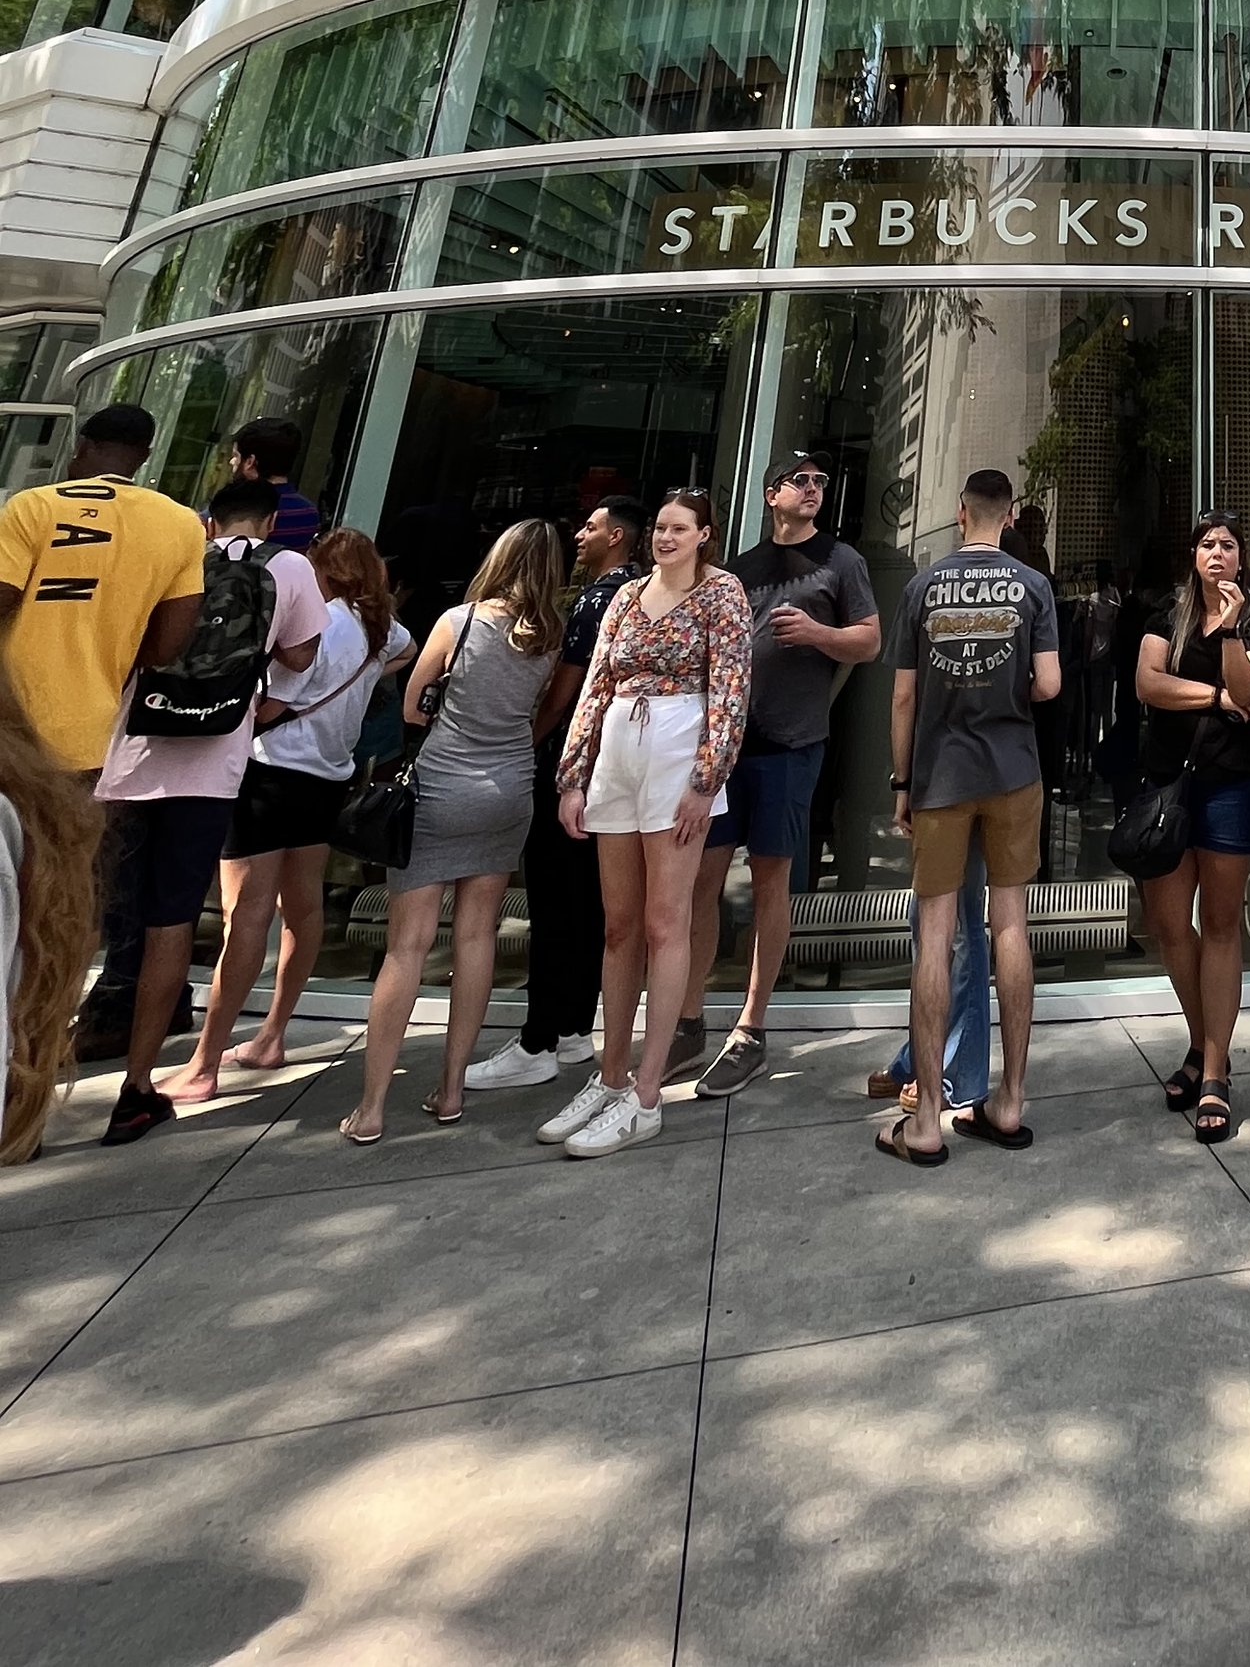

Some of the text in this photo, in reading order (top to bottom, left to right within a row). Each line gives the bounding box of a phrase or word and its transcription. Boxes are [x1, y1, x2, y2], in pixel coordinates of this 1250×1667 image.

[659, 197, 1149, 256] STRBUCKS
[924, 580, 1025, 608] CHICAGO
[962, 642, 978, 658] AT
[985, 641, 1014, 671] DELI
[145, 692, 241, 722] Champion
